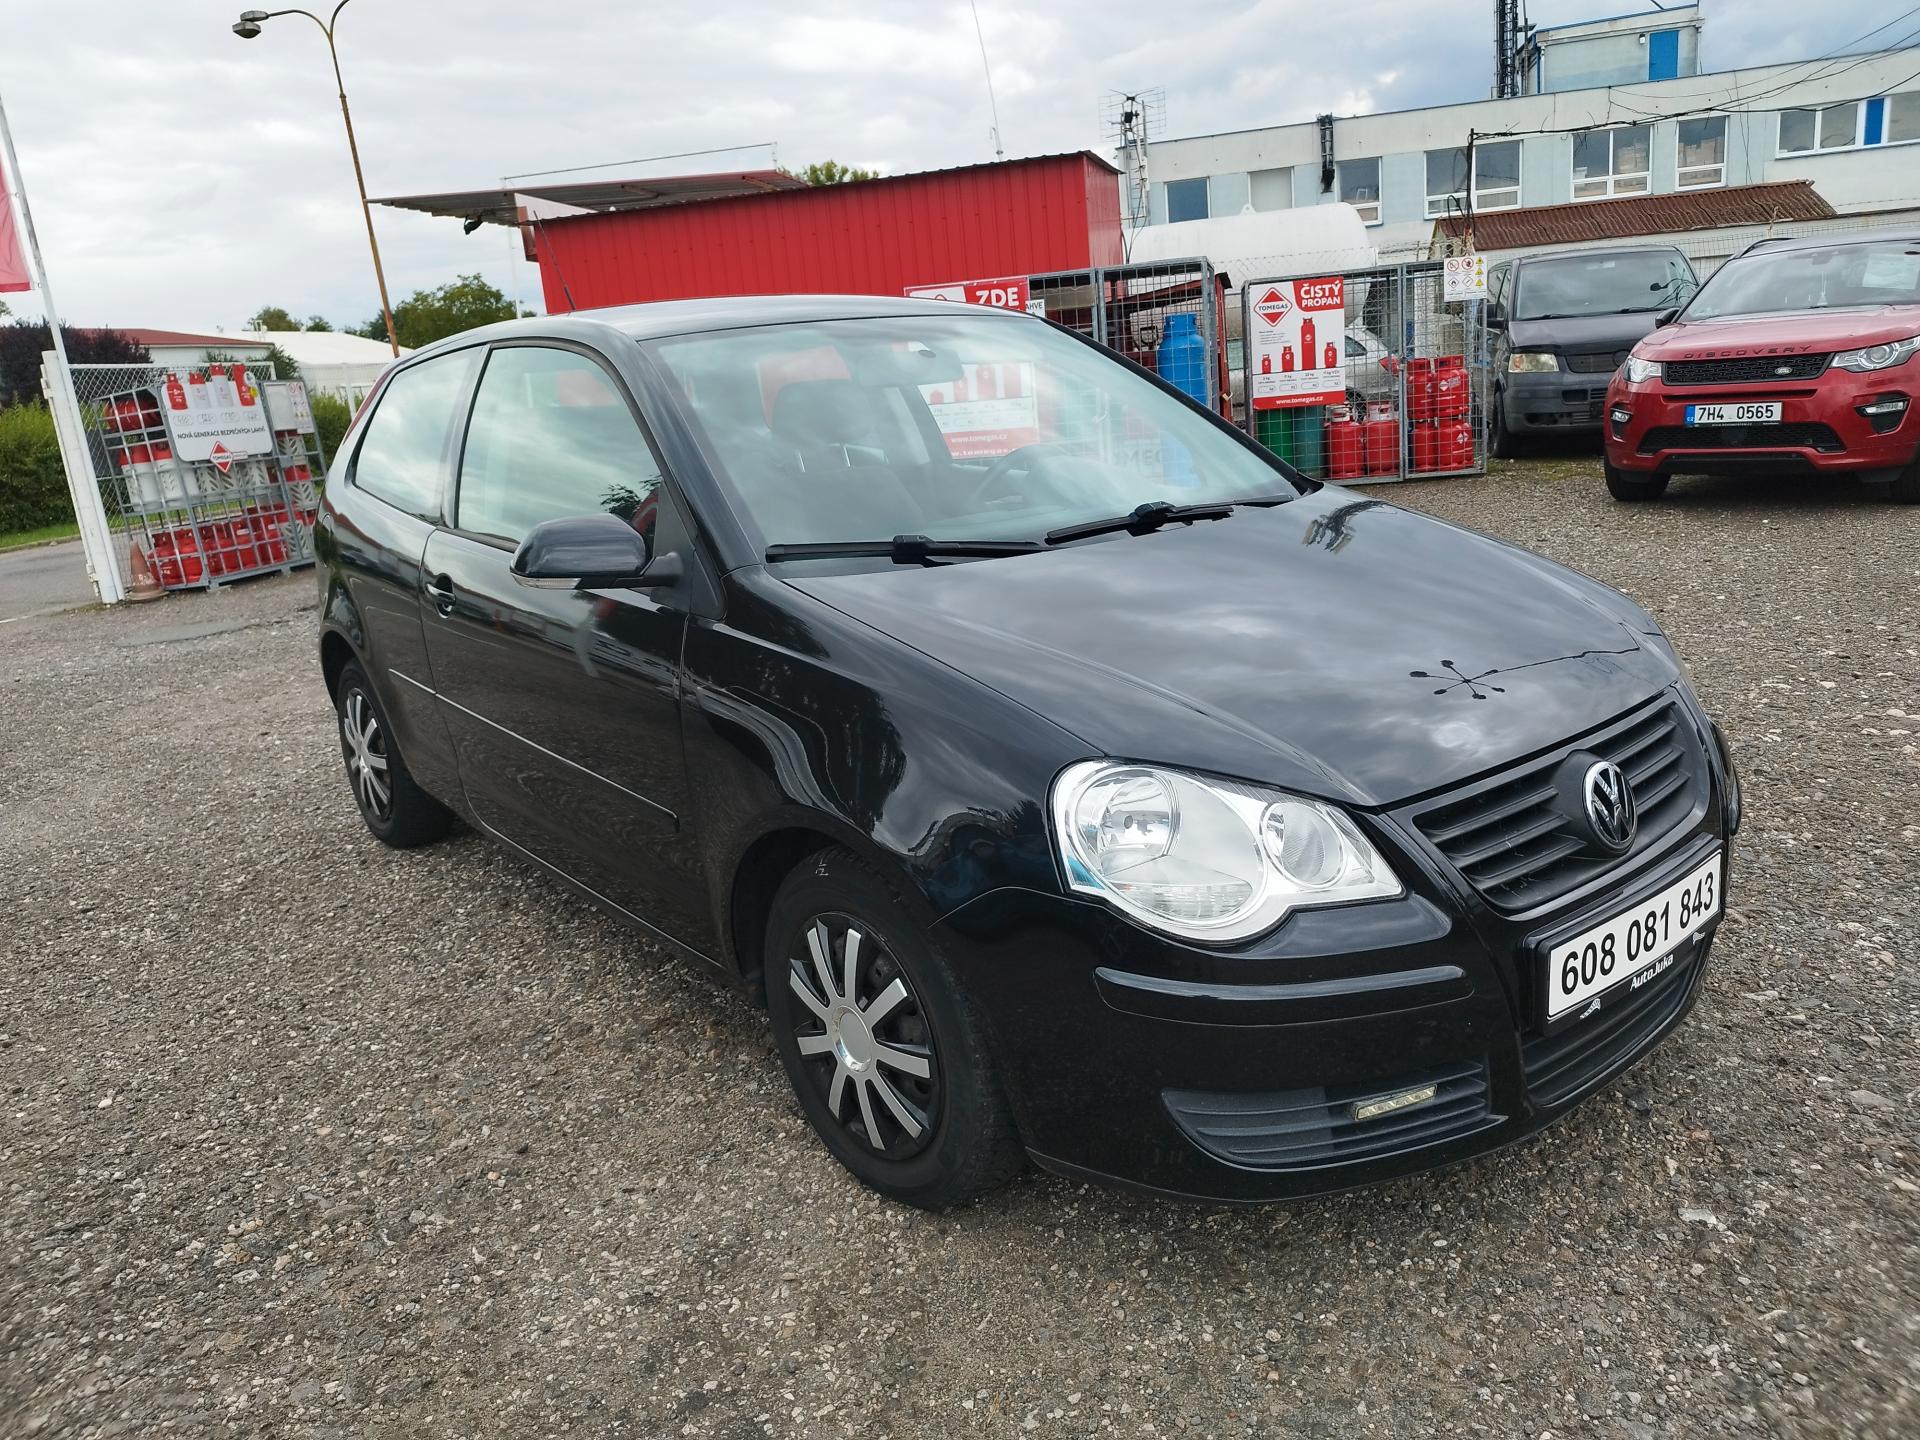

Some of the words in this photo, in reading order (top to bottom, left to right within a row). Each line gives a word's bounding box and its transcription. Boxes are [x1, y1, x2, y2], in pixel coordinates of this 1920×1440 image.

[975, 287, 1019, 307] ZDE
[1300, 280, 1341, 299] ČISTÝ
[1258, 303, 1288, 312] TOMEGAS
[1301, 296, 1340, 308] PROPAN
[1684, 345, 1811, 359] DISCOVERY
[1698, 406, 1725, 421] 7H4
[1736, 404, 1774, 420] 0565
[1561, 932, 1616, 996] 608
[1626, 901, 1670, 962] 081
[1679, 871, 1714, 929] 843
[1629, 954, 1674, 991] AutoJuka
